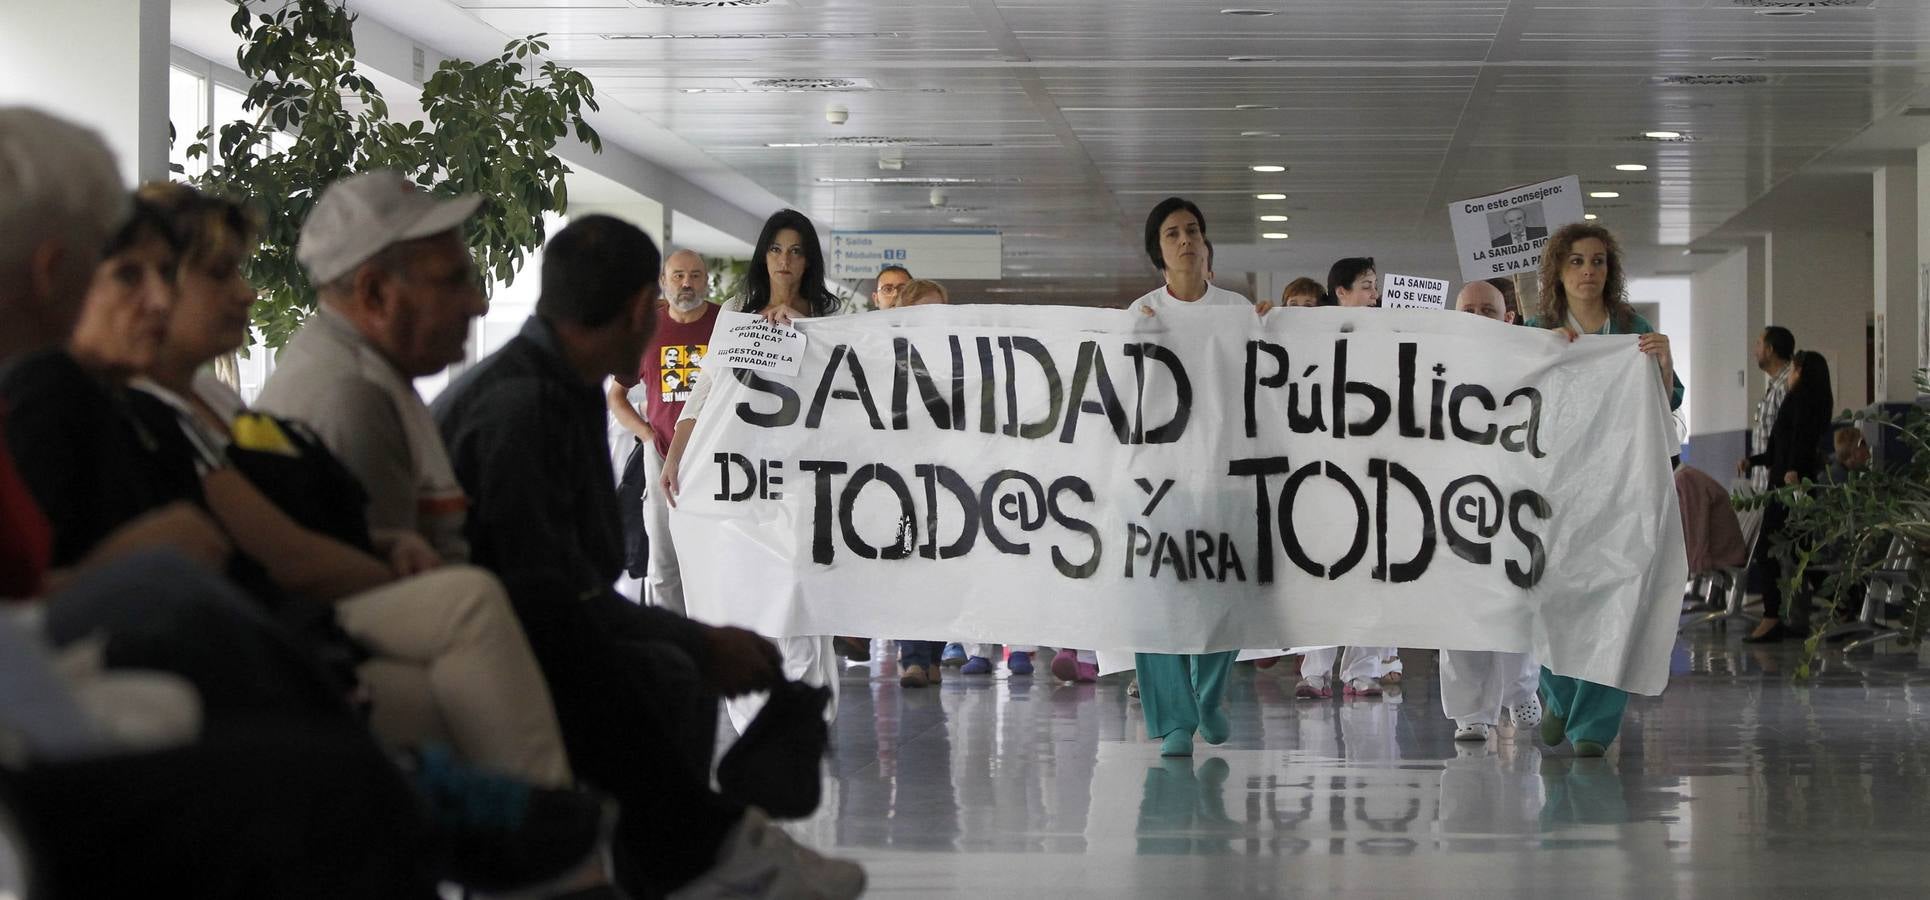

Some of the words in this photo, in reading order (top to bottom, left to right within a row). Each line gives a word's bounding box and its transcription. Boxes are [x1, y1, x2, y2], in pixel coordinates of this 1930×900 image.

[1464, 203, 1485, 214] Con
[1487, 199, 1509, 210] este
[1511, 185, 1562, 205] consejero:
[845, 237, 872, 246] Salida
[1473, 250, 1486, 261] LA
[1488, 242, 1530, 258] SANIDAD
[845, 264, 872, 273] Planta
[1492, 262, 1505, 273] SE
[1506, 260, 1520, 270] VA
[1522, 258, 1530, 268] A
[1393, 276, 1405, 287] LA
[1407, 278, 1442, 291] SANIDAD
[1387, 289, 1401, 299] NO
[1403, 291, 1415, 301] SE
[1417, 293, 1443, 305] VENDE,
[729, 324, 768, 334] ¿GESTOR
[770, 328, 784, 336] DE
[785, 331, 797, 339] LA
[728, 356, 777, 368] PRIVADA!!!
[766, 352, 779, 360] DE
[781, 354, 793, 363] LA
[734, 335, 1192, 445] SANIDAD
[1245, 338, 1546, 458] Pública
[714, 452, 783, 501] DE
[800, 461, 1101, 579] TOD@S
[1124, 523, 1246, 583] PARA
[1228, 457, 1552, 589] TOD@S
